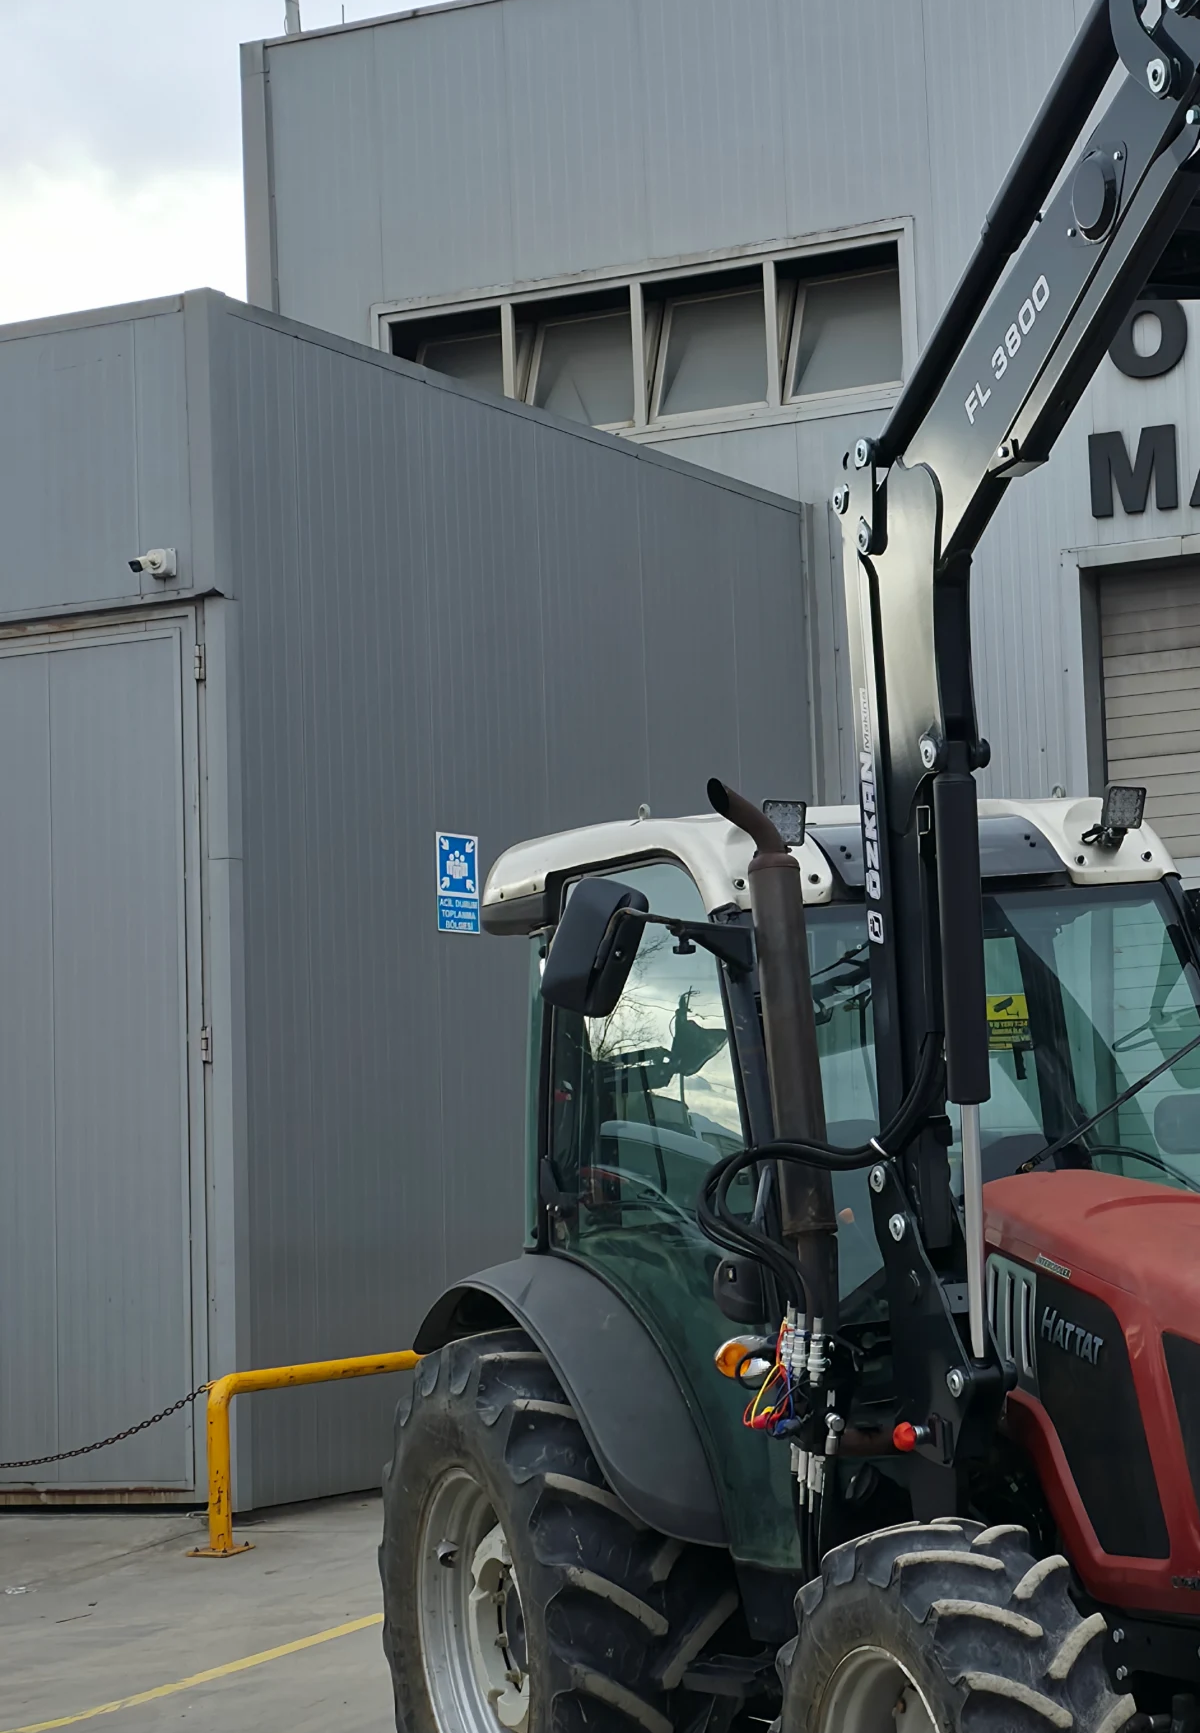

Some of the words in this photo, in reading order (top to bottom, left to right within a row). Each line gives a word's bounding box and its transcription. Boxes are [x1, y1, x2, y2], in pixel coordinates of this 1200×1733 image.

[965, 382, 992, 425] FL
[991, 274, 1050, 380] 3800
[1041, 1306, 1104, 1365] HATTAT
